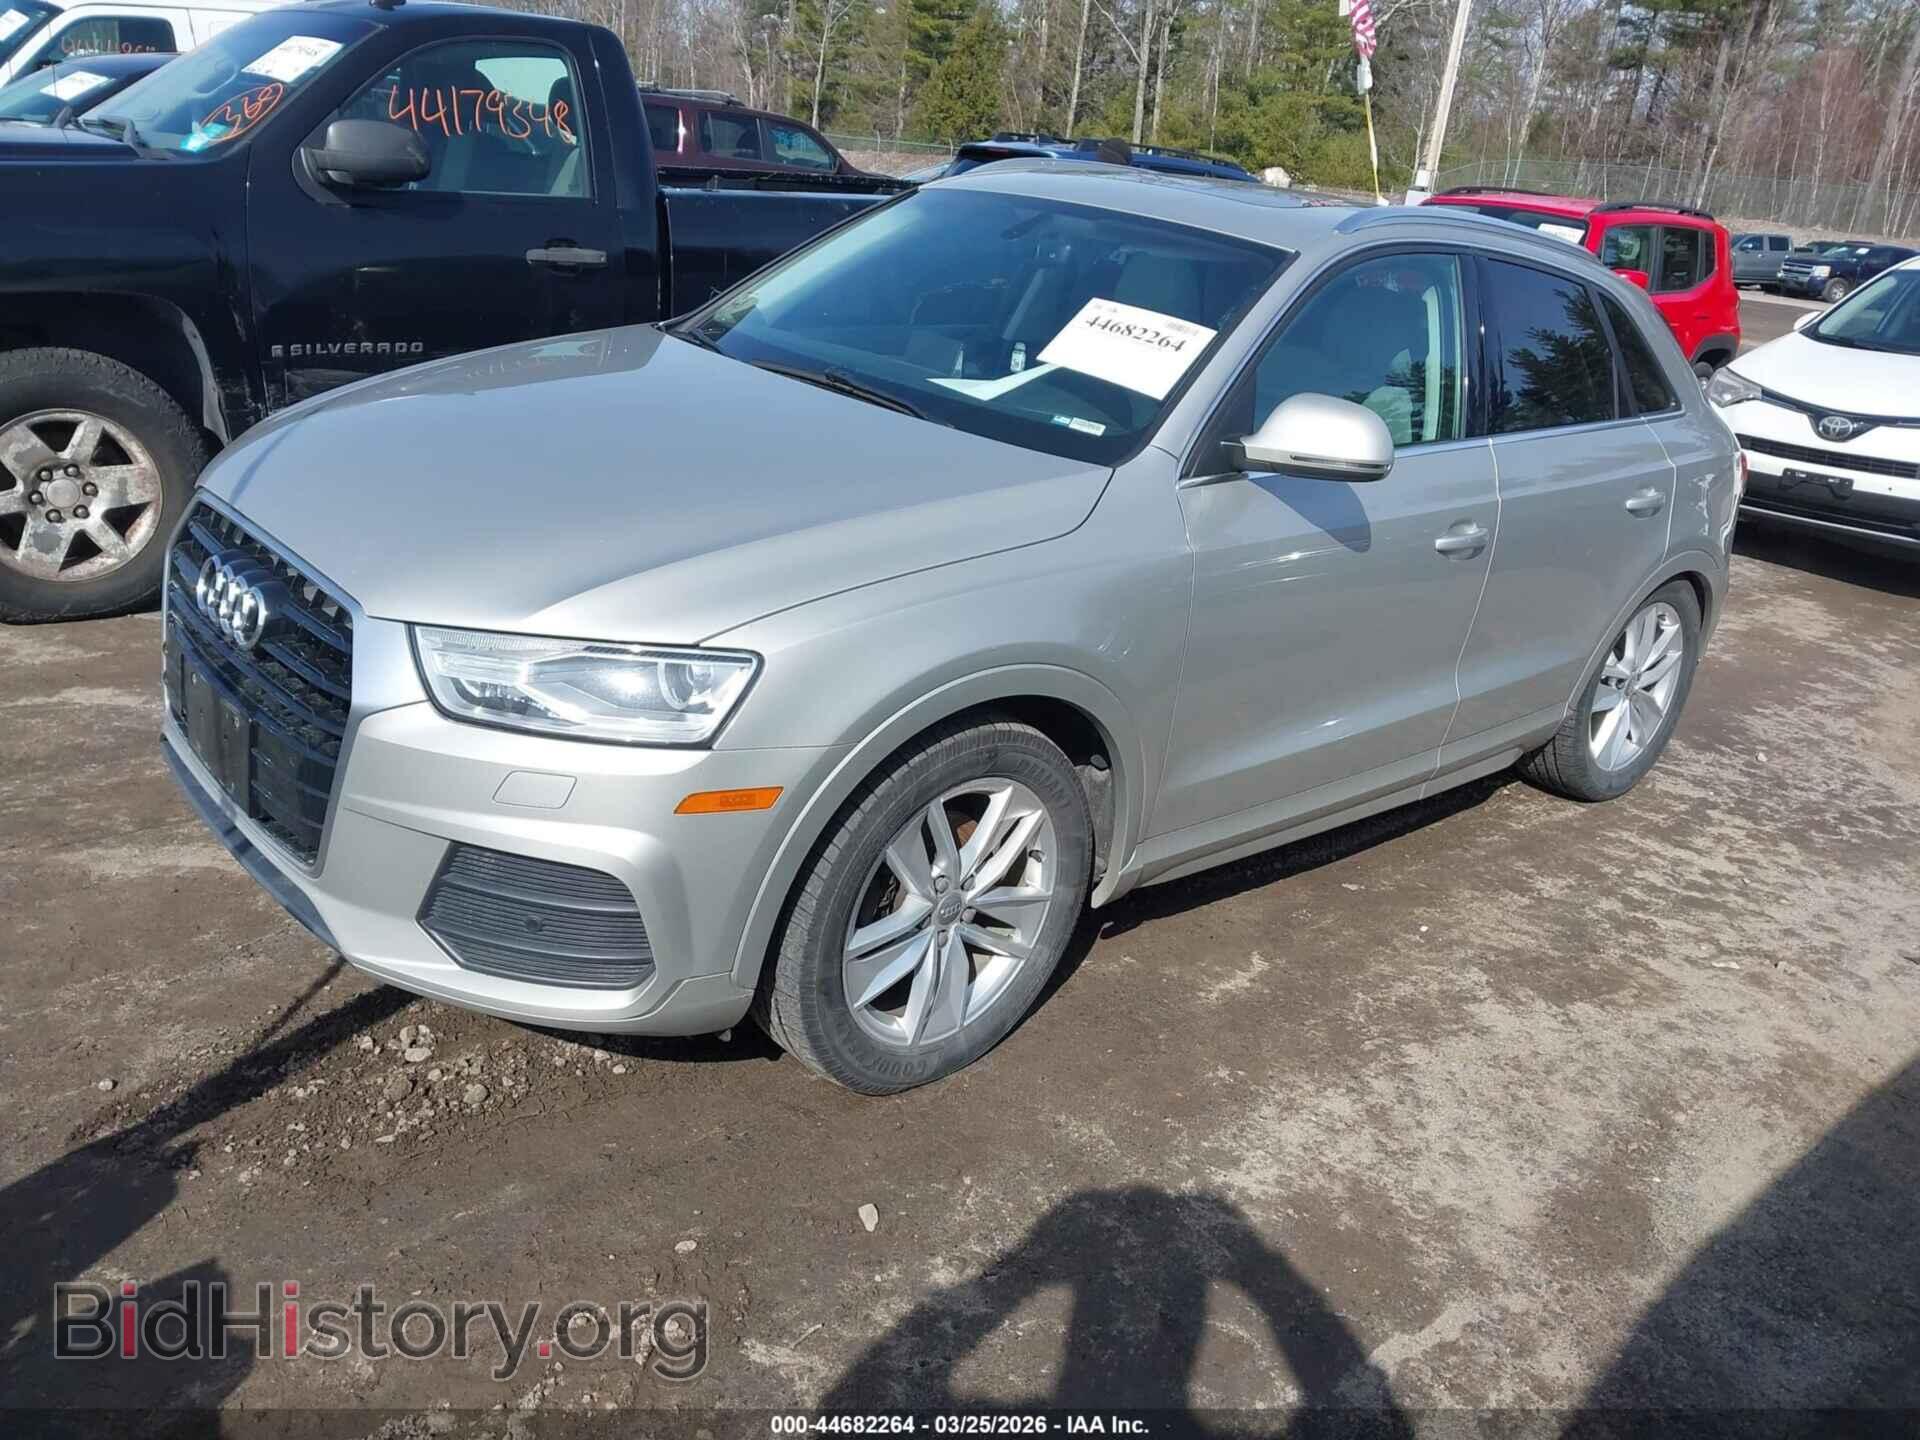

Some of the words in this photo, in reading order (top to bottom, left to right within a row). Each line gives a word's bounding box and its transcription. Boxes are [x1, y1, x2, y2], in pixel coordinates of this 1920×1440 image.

[388, 84, 576, 145] 44179348
[289, 341, 424, 357] SILVERADO
[1085, 316, 1187, 352] 44682264
